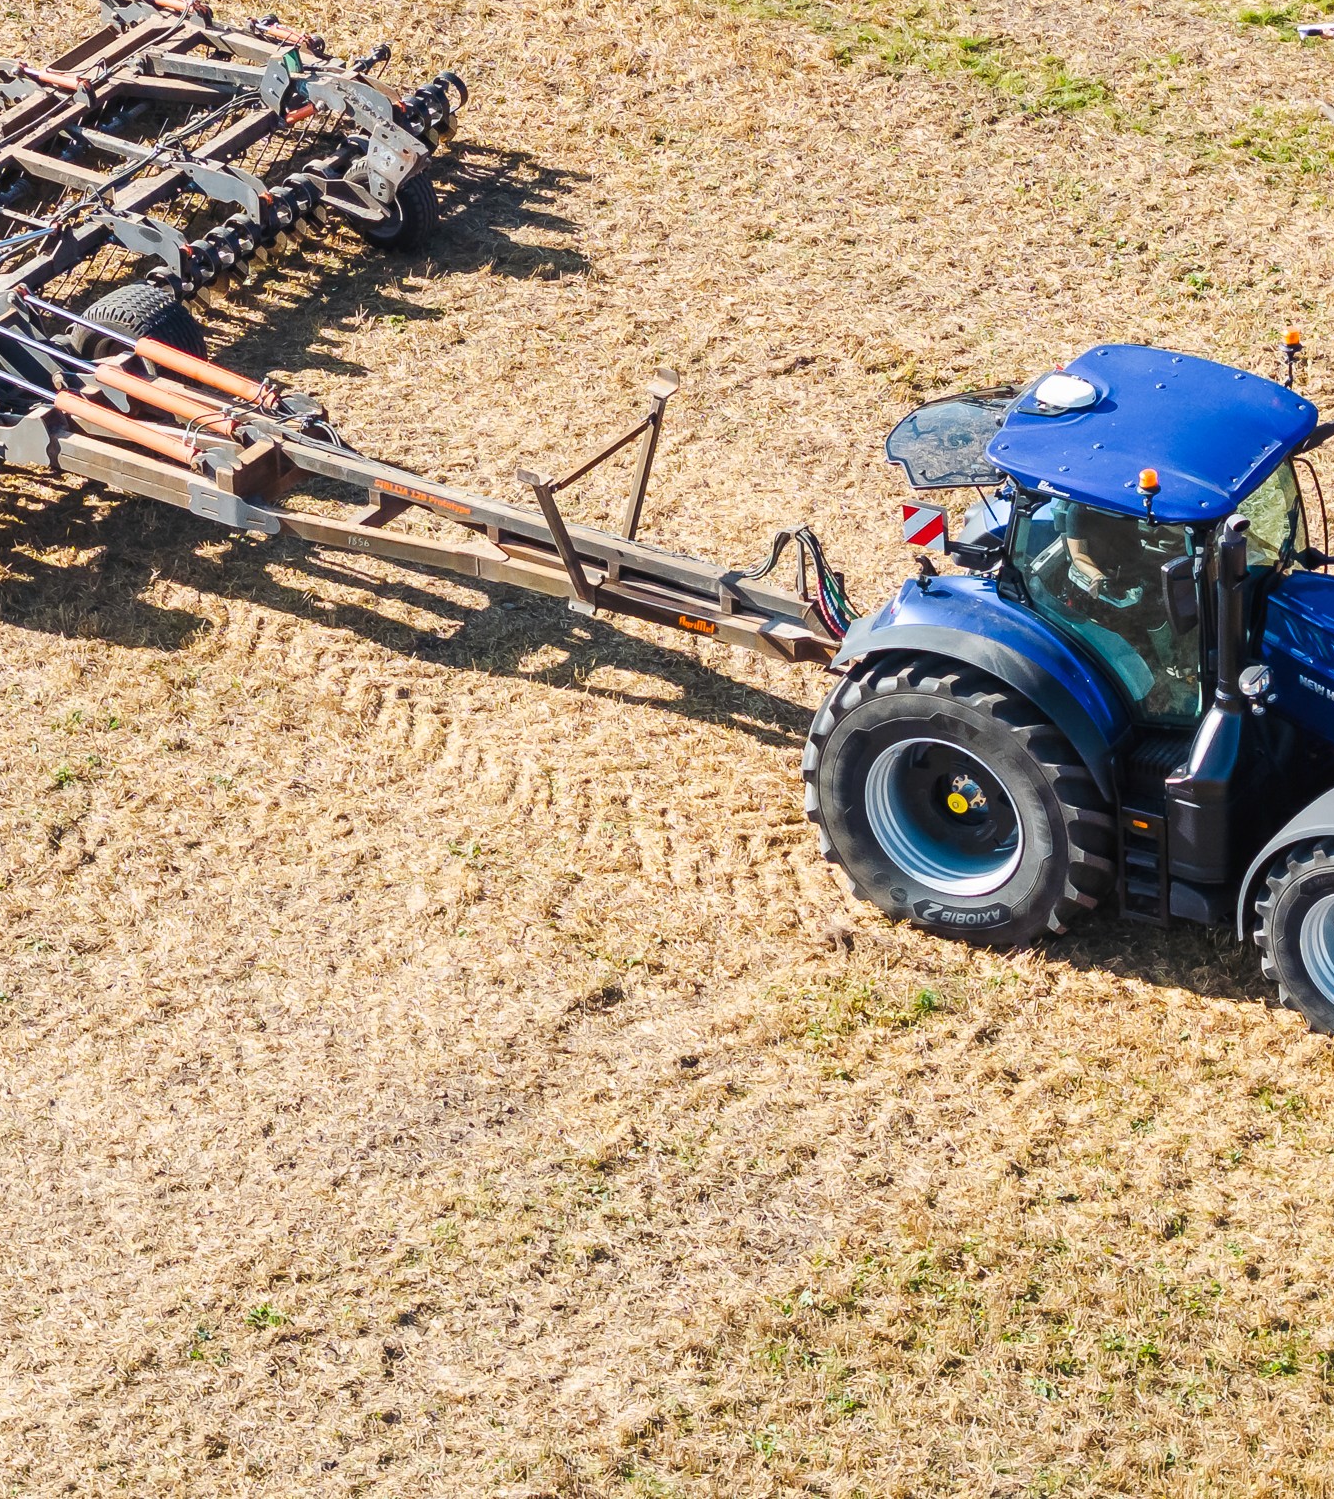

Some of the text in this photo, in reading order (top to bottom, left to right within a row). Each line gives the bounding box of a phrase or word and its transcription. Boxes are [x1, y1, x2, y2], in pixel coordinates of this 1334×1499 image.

[1299, 674, 1325, 696] NEW
[922, 902, 1001, 925] AXIOBIB 2
